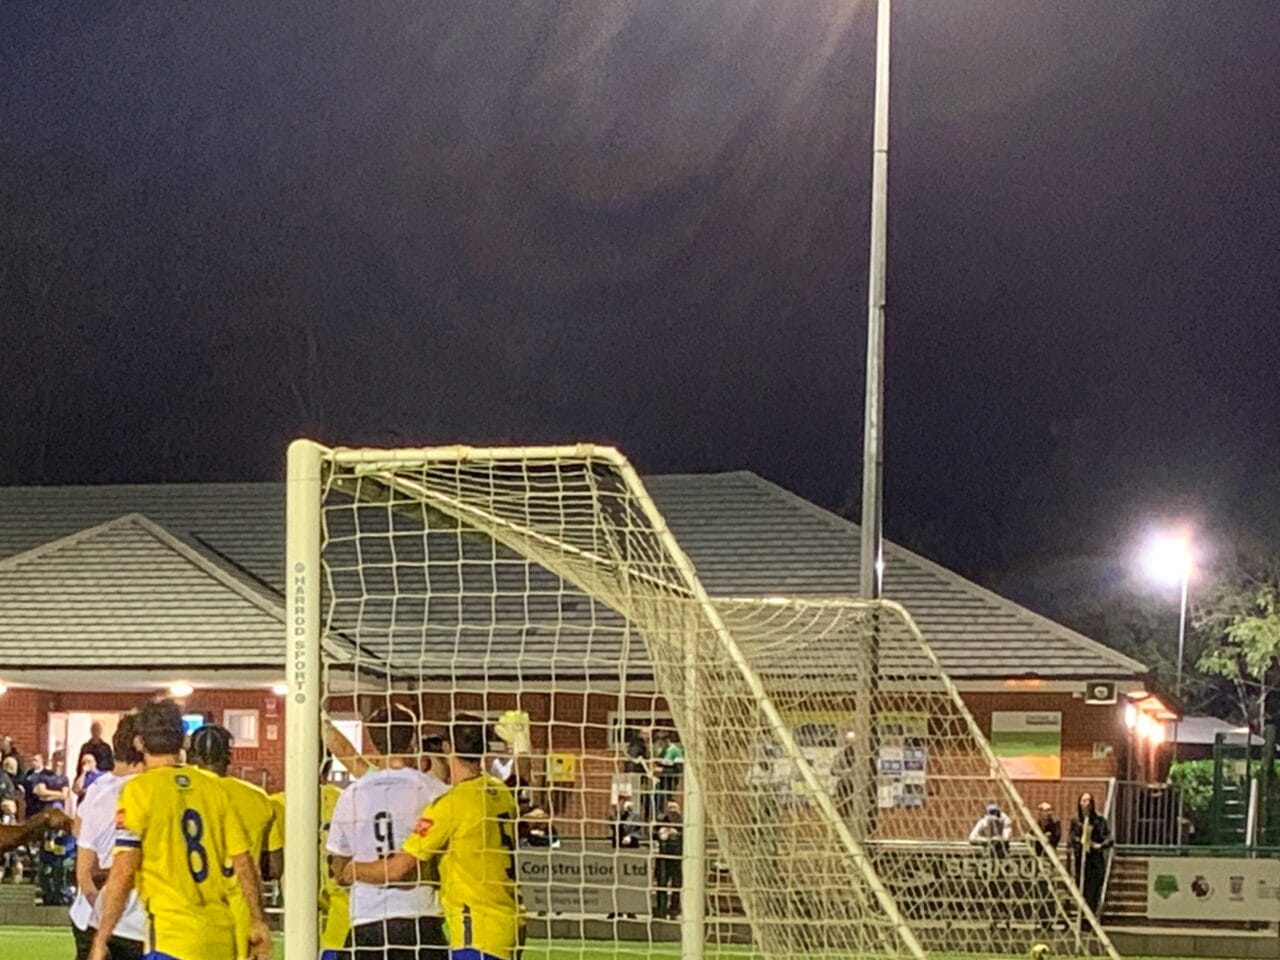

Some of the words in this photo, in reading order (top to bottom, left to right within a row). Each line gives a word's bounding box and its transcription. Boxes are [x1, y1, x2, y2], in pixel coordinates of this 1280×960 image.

[294, 576, 306, 636] HARROD
[294, 641, 306, 690] SPORT
[181, 808, 209, 883] 8
[374, 811, 394, 860] 9
[623, 861, 648, 876] Ltd
